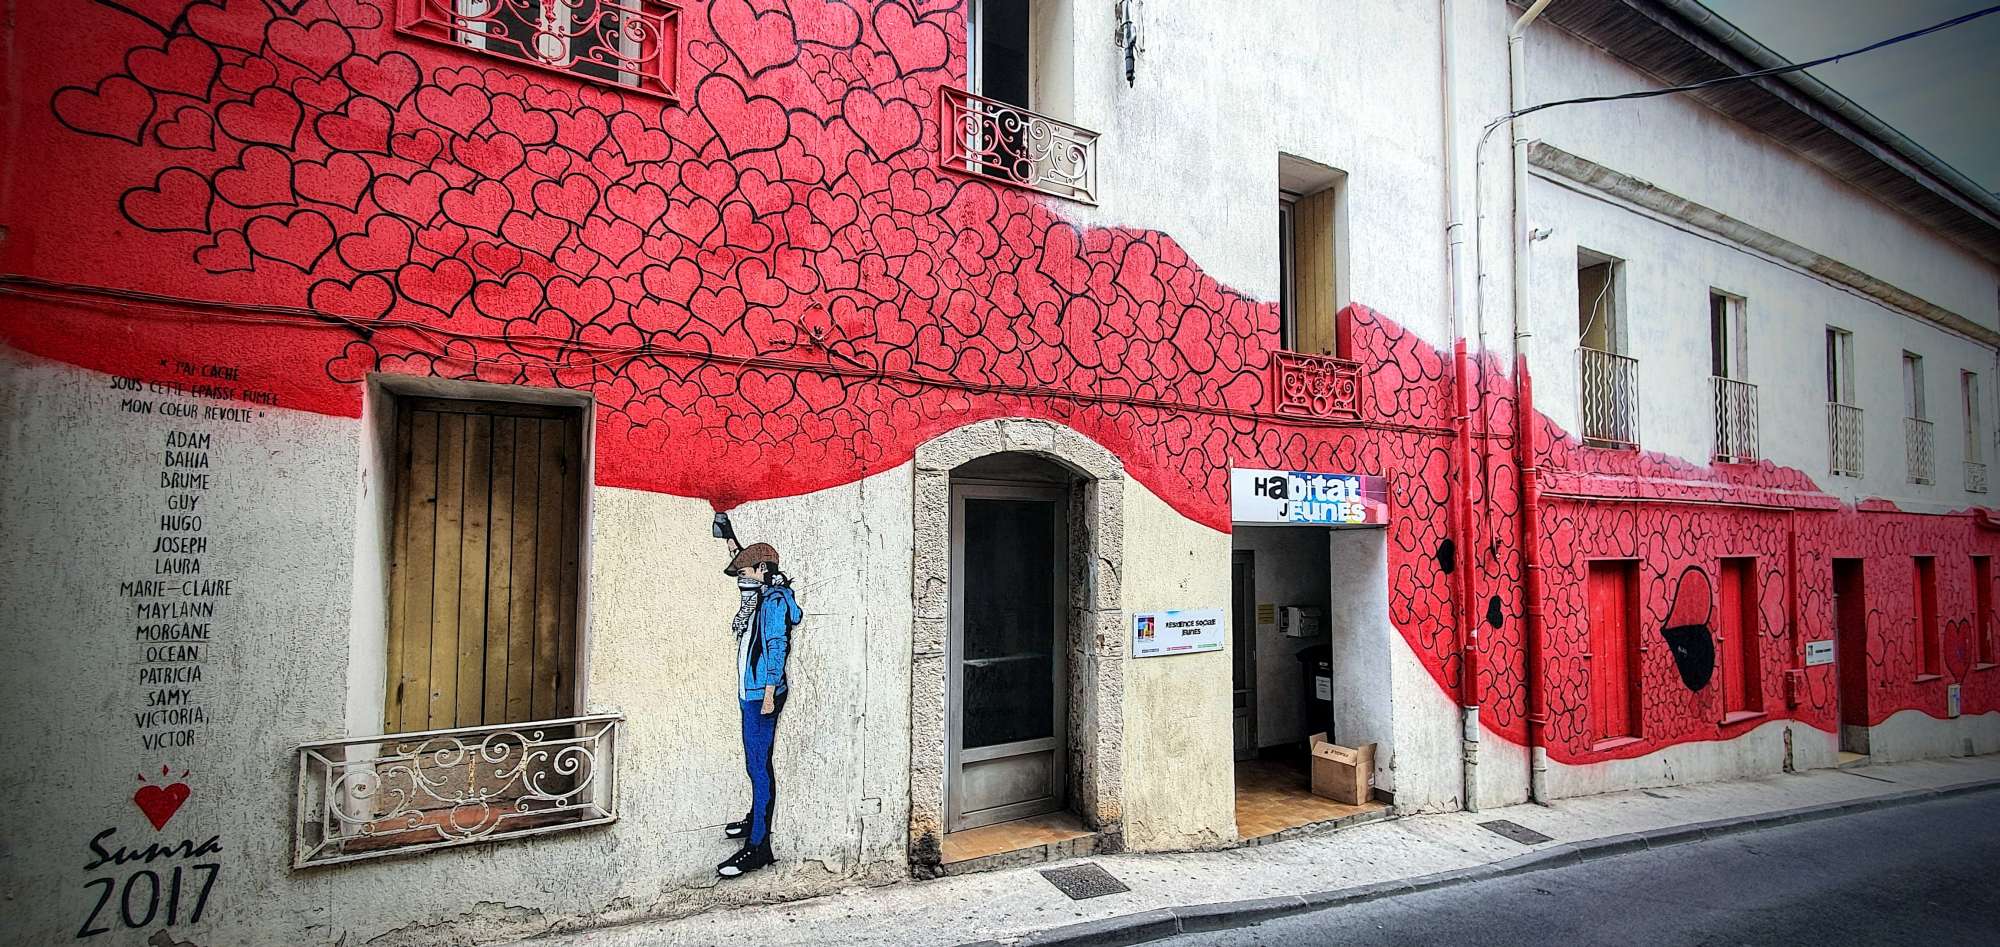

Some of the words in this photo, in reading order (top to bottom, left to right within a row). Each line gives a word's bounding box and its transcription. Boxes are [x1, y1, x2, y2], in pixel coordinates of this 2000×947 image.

[110, 376, 143, 392] SOUS
[150, 380, 185, 397] CETTE
[121, 399, 152, 414] MON
[160, 401, 198, 418] COEUR
[204, 404, 252, 423] RÉVOLTÉ
[166, 431, 211, 450] ADAM
[165, 451, 209, 468] BAHIA
[161, 471, 210, 489] BRUME
[1254, 474, 1360, 503] Habitat
[168, 494, 199, 511] GUY
[161, 515, 202, 532] HUGO
[153, 537, 207, 554] JOSEPH
[155, 558, 200, 575] LAURA
[137, 601, 214, 619] MAYLANN
[136, 623, 211, 641] MORGANE
[146, 645, 199, 662] OCEAN
[139, 665, 201, 685] PATRICIA
[147, 689, 192, 707] SAMY
[143, 729, 195, 750] VICTOR
[83, 827, 224, 870] Sunra
[76, 863, 221, 939] 2017
